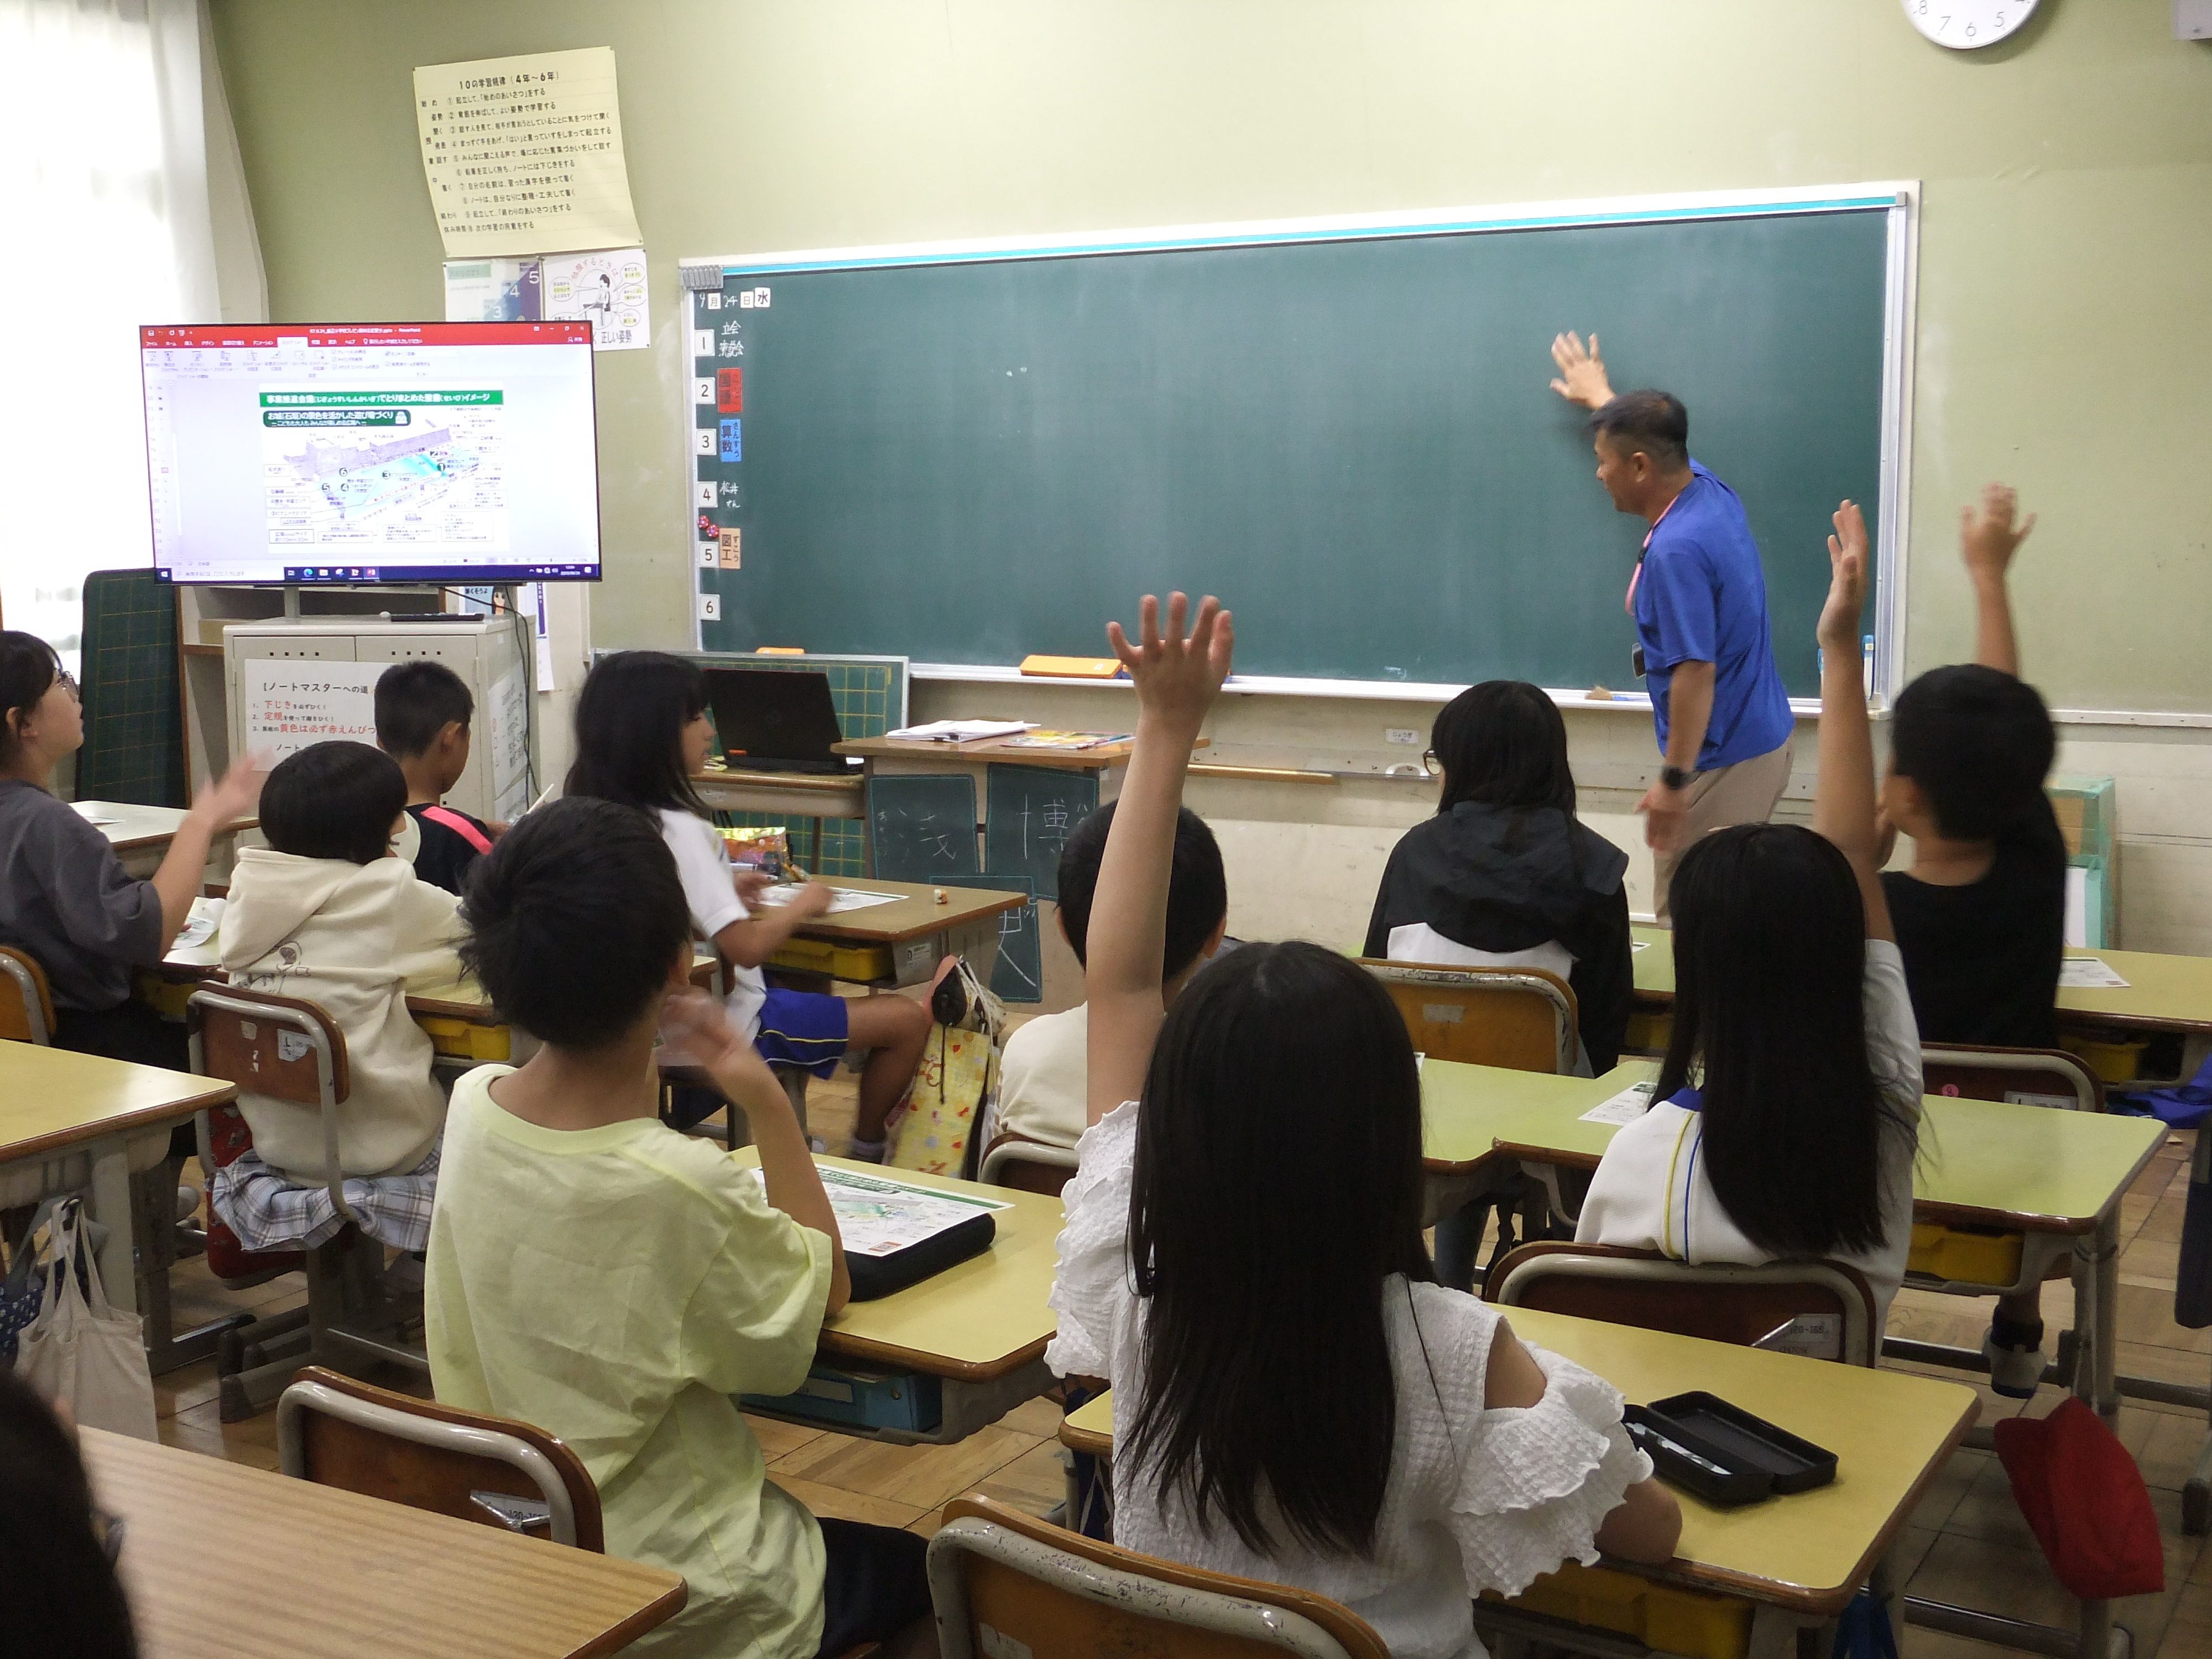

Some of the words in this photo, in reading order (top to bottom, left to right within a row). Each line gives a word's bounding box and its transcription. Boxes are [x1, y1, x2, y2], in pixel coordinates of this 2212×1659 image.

[1919, 0, 1928, 14] 8
[1941, 16, 1951, 31] 7
[1995, 11, 2005, 27] 5
[1965, 22, 1976, 36] 6
[529, 271, 539, 284] 5
[510, 285, 519, 297] 4
[493, 306, 502, 318] 3
[721, 320, 742, 335] 立会
[702, 336, 706, 350] 1
[701, 384, 708, 397] 2
[702, 435, 709, 448] 3
[722, 425, 733, 452] 算数
[703, 488, 711, 501] 4
[722, 534, 732, 561] 図工
[705, 548, 712, 561] 5
[706, 601, 713, 614] 6
